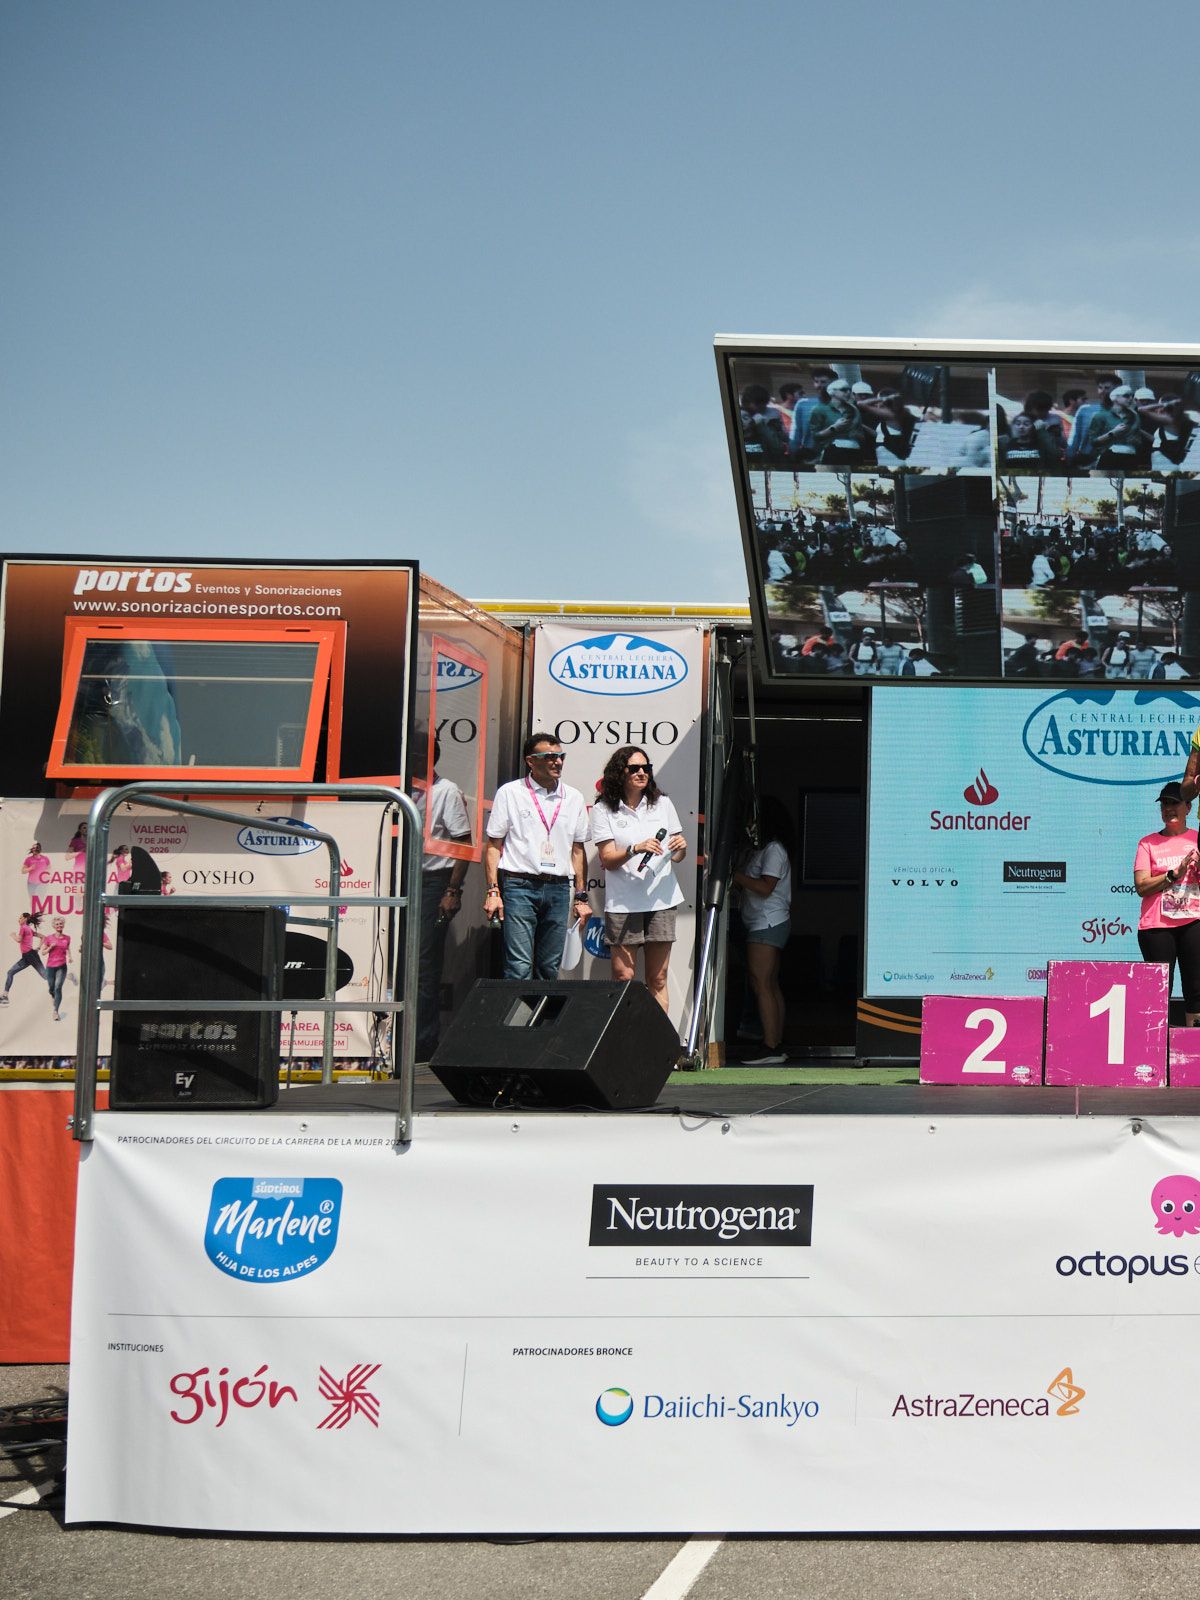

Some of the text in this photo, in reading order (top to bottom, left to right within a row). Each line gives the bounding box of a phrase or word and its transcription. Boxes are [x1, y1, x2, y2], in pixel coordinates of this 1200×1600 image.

[73, 569, 342, 597] portos Eventos y Sonorizaciones
[73, 599, 341, 617] www.sonorizacionesportos.com
[581, 654, 674, 662] CENTRAL LECHERA
[558, 655, 677, 681] ASTURIANA
[1070, 712, 1134, 723] CENTRAL
[554, 719, 679, 746] OYSHO
[1038, 714, 1192, 756] ASTURIAN
[930, 810, 1031, 831] Santander
[133, 825, 187, 834] VALENCIA
[144, 837, 156, 845] DE
[157, 837, 182, 845] JUNIO
[39, 871, 119, 884] CARRA
[183, 869, 254, 885] OYSHO
[1008, 866, 1062, 880] Neutrogena
[64, 886, 78, 894] DE
[314, 878, 372, 889] Saander
[892, 879, 959, 887] VOLVO
[1110, 884, 1137, 896] octop
[1081, 916, 1133, 944] gijón
[950, 971, 987, 981] AstraZeneca
[1089, 984, 1127, 1065] 1
[962, 1007, 1008, 1074] 2
[117, 1136, 194, 1145] PATROCINADORES
[196, 1136, 213, 1145] DEL
[215, 1137, 256, 1145] CIRCUITO
[258, 1137, 270, 1146] DE
[272, 1137, 283, 1146] LA
[285, 1137, 325, 1146] CARRERA
[327, 1138, 338, 1146] DE
[340, 1138, 351, 1146] LA
[354, 1138, 383, 1146] MUJER
[606, 1197, 798, 1240] Neutrogena
[213, 1199, 332, 1255] Marlene
[216, 1252, 318, 1278] HIJA DE LOS ALPES
[635, 1258, 763, 1266] BEAUTY TO A SCIENCE
[108, 1343, 164, 1353] INSTITUCIONES
[512, 1347, 633, 1356] PATROCINADORES BRONCE
[169, 1364, 298, 1428] gijón
[643, 1393, 819, 1427] Daiichi-Sankyo
[891, 1394, 1049, 1417] AstraZeneca
